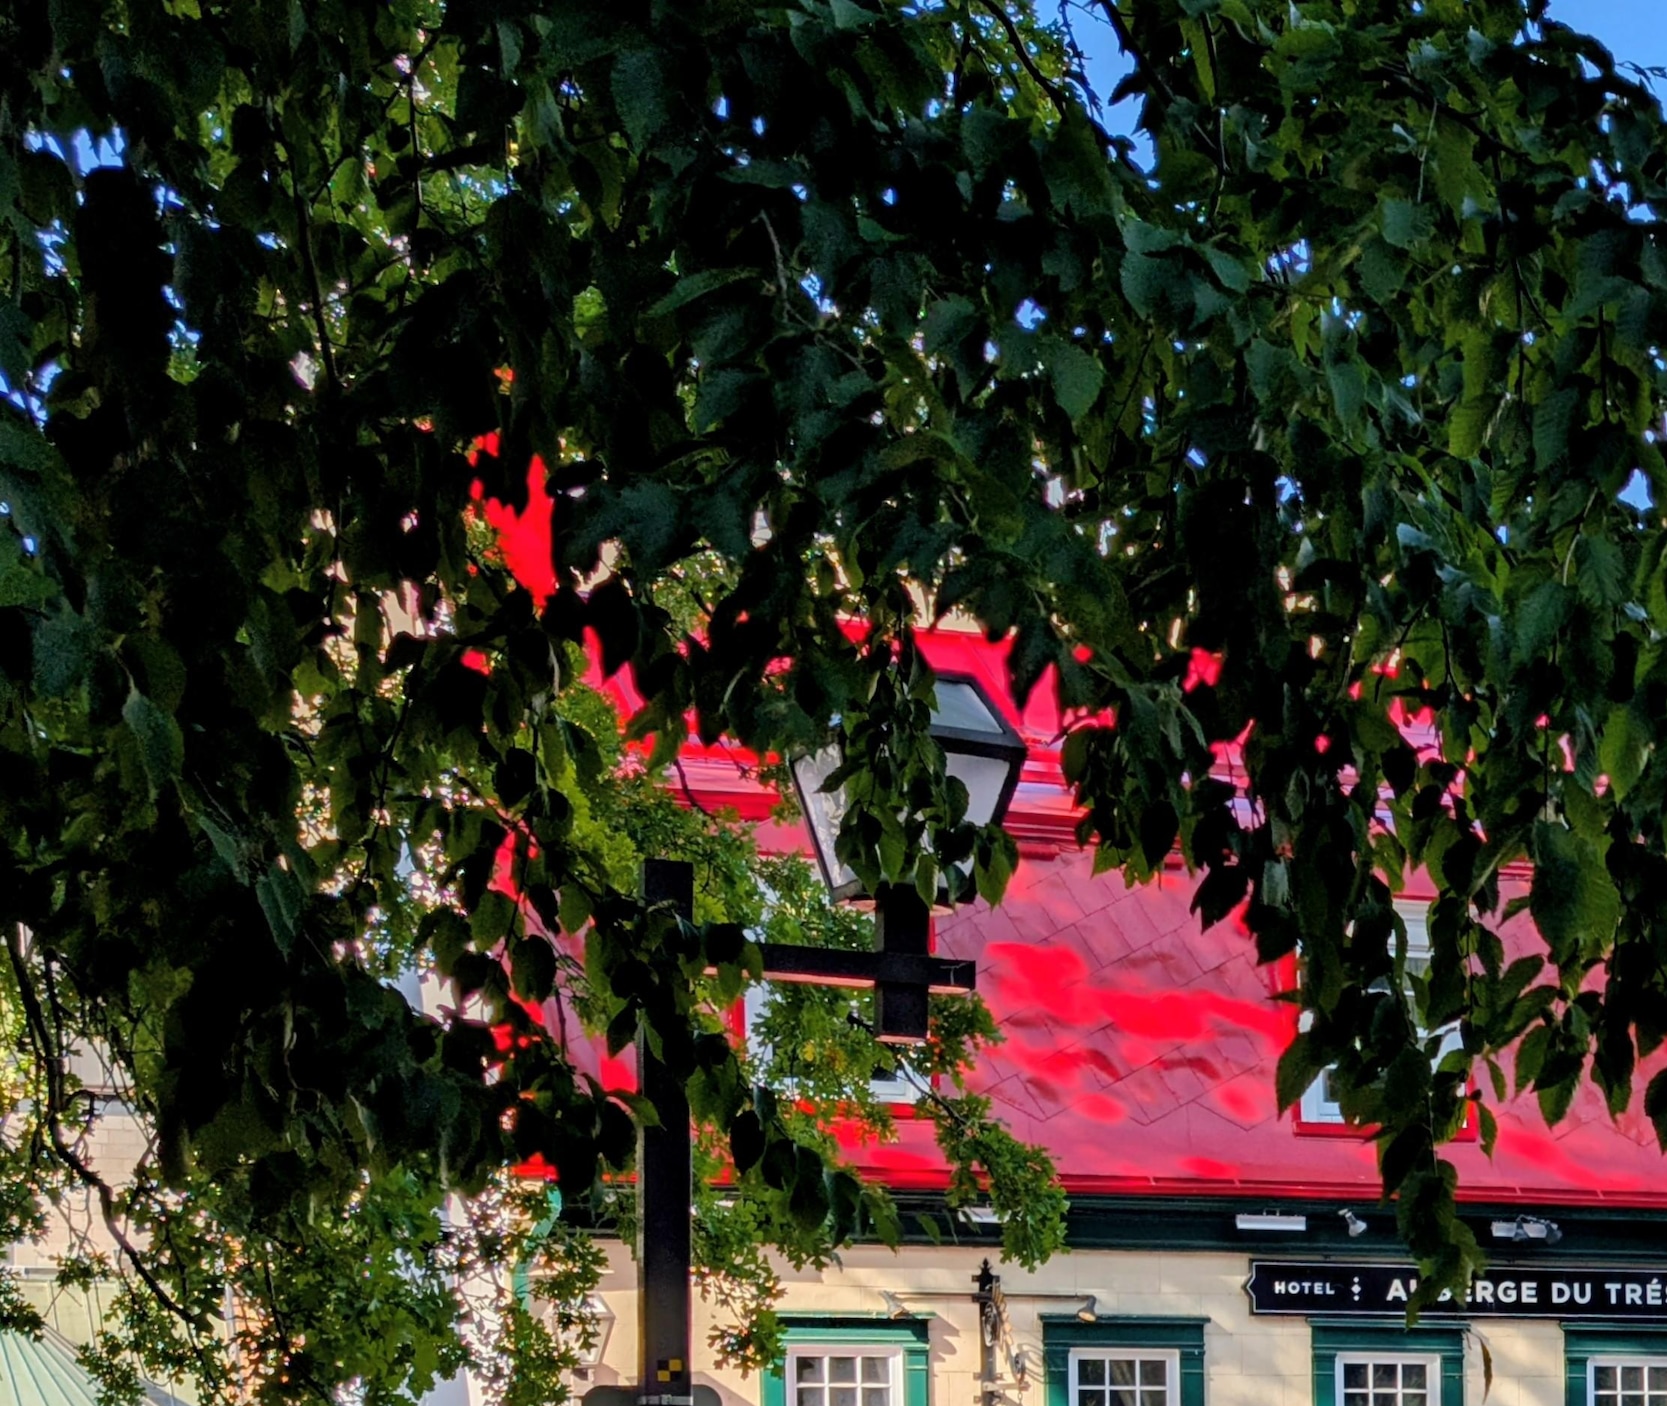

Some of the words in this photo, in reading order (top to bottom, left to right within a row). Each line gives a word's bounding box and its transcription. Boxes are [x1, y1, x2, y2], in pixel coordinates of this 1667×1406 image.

[1274, 1280, 1335, 1296] HOTEL
[1386, 1279, 1538, 1304] ARGE
[1551, 1281, 1592, 1305] DU
